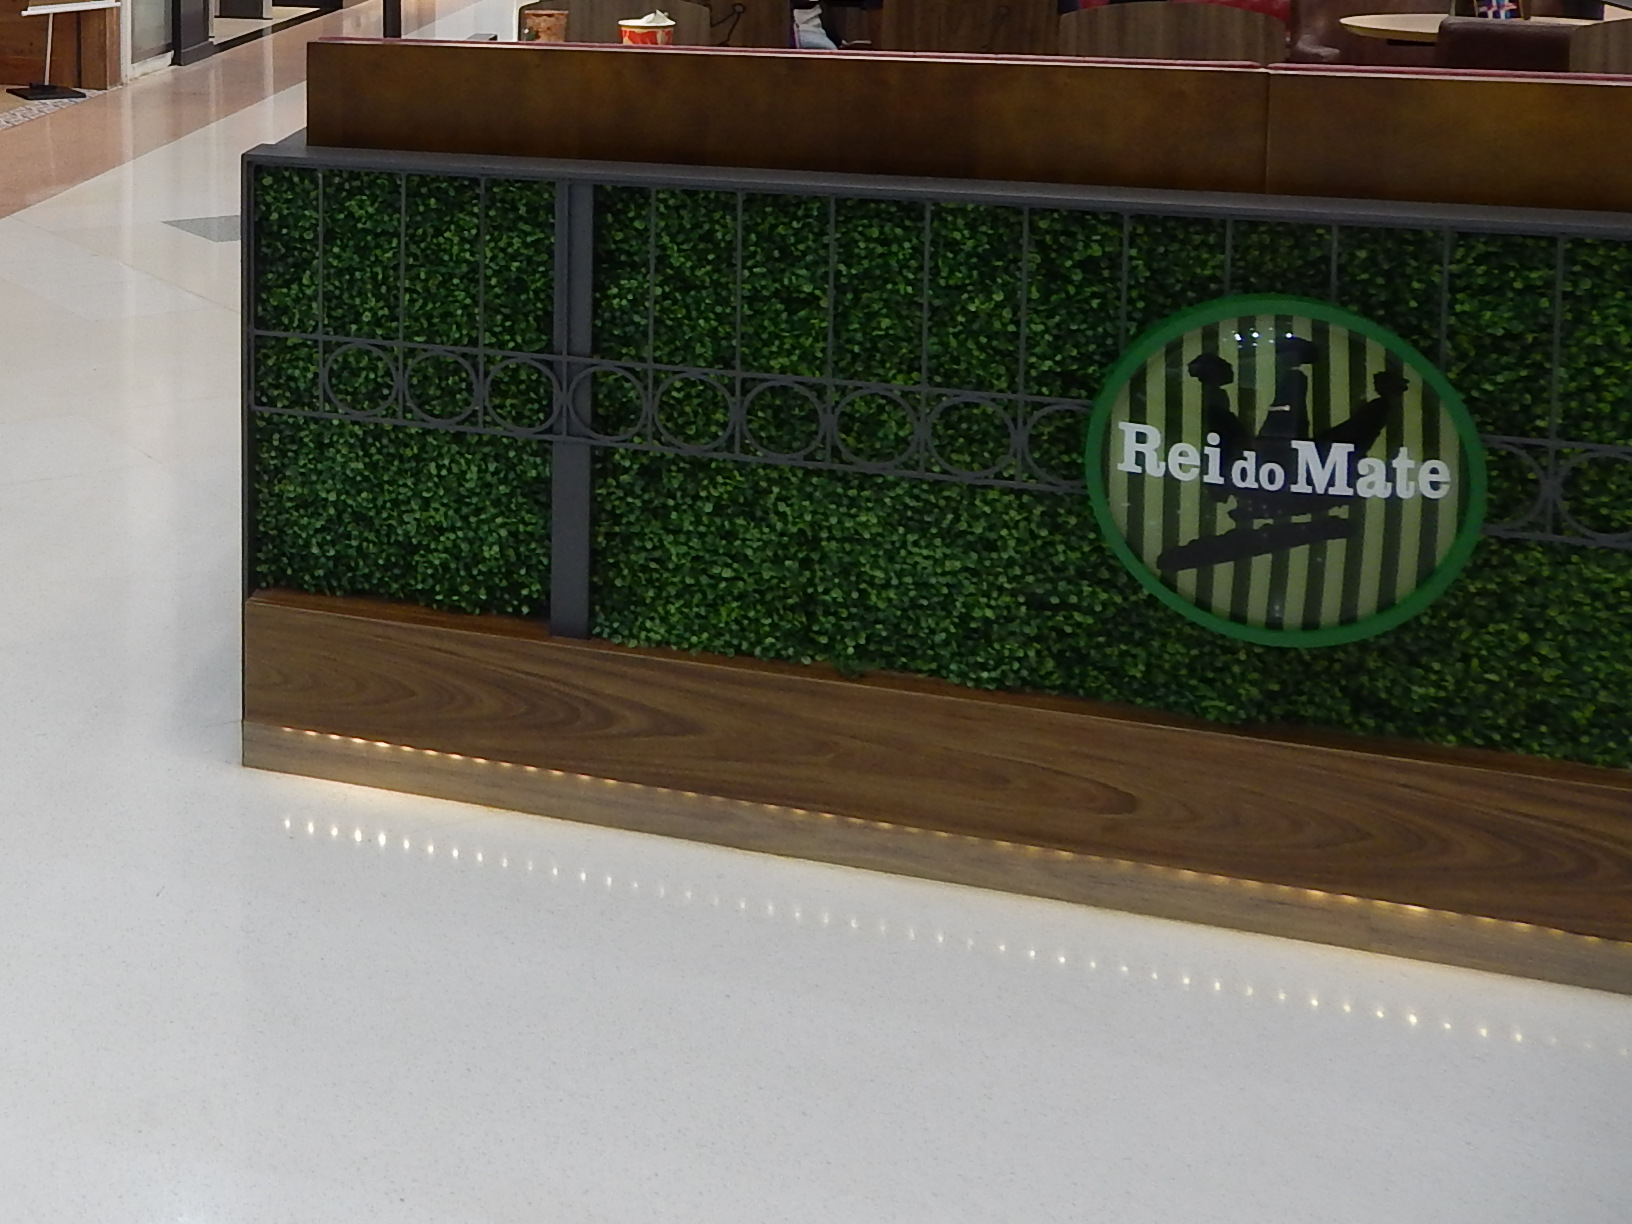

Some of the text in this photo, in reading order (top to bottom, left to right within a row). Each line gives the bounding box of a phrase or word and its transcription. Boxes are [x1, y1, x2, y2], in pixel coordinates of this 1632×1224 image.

[1117, 421, 1452, 500] Rei do Mate
